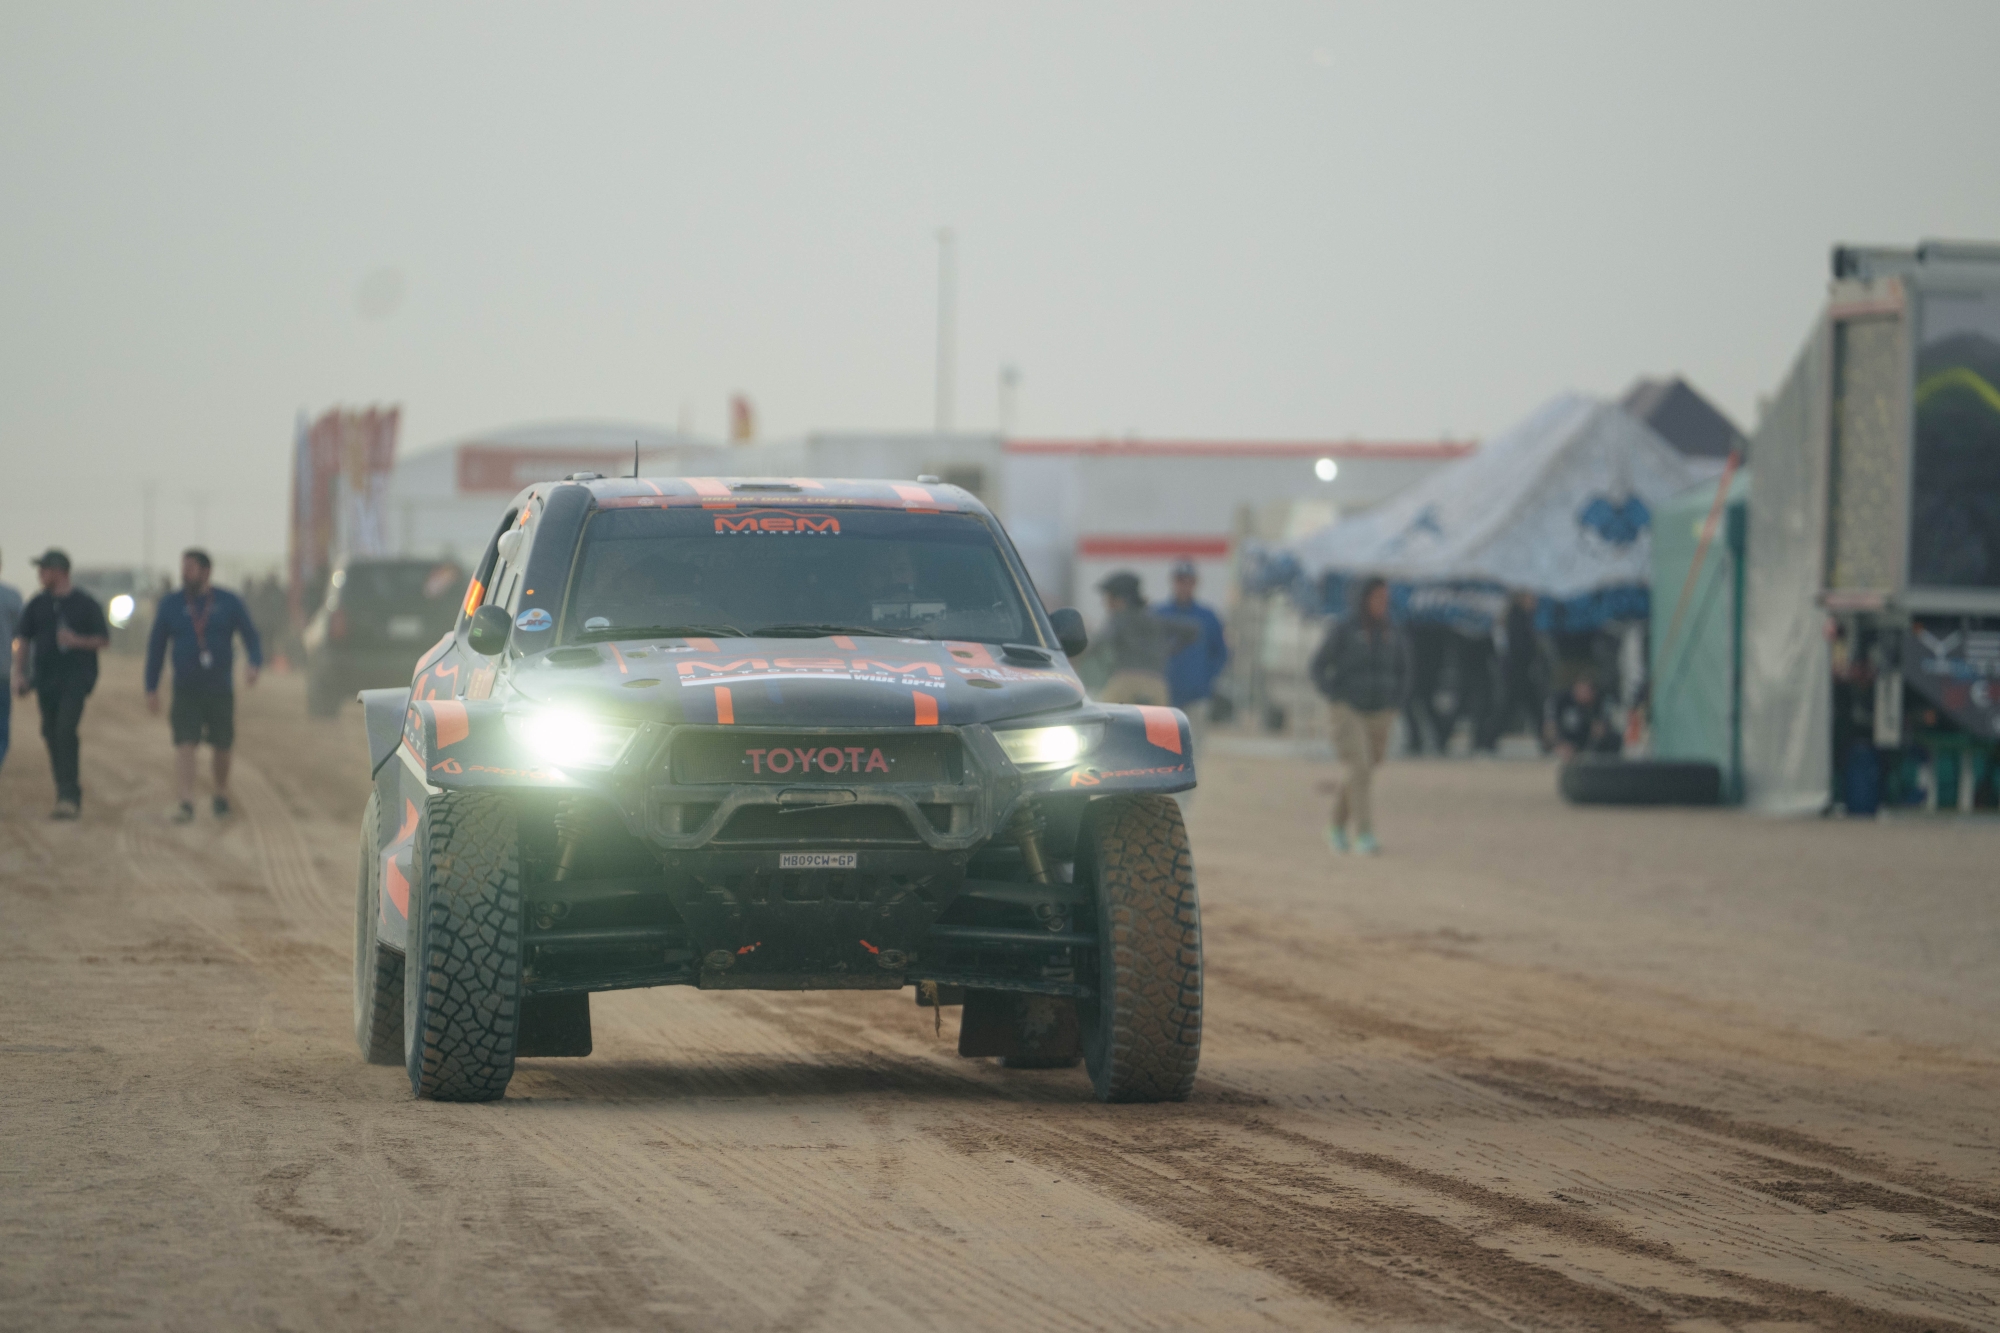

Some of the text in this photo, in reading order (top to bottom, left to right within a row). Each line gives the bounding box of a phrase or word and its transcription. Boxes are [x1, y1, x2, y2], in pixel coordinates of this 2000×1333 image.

[854, 674, 946, 688] WIDE OPEN
[745, 746, 889, 774] TOYOTA
